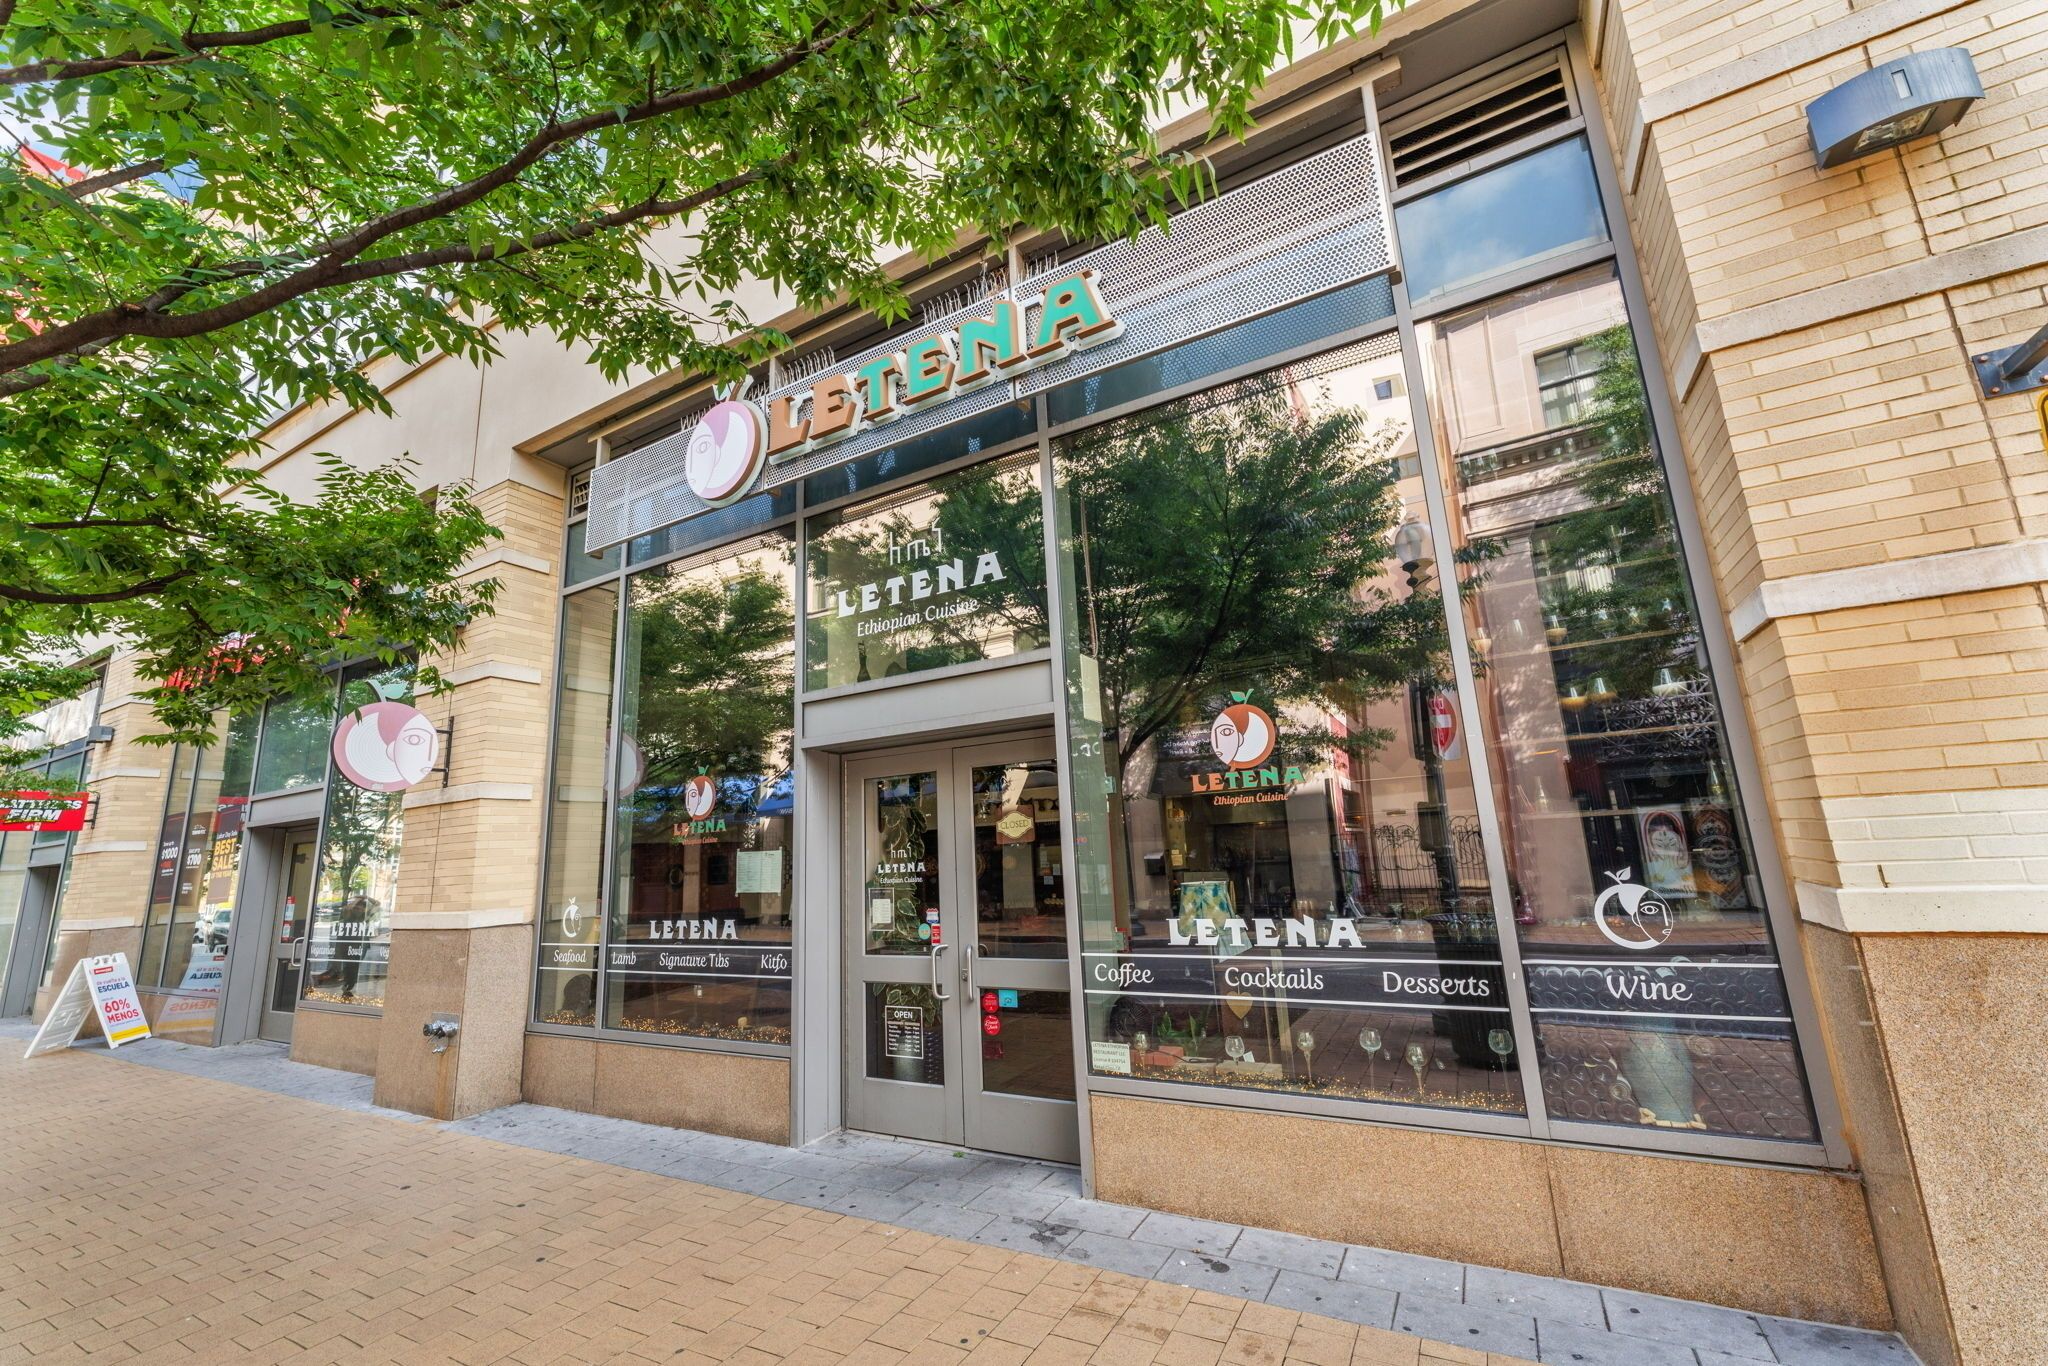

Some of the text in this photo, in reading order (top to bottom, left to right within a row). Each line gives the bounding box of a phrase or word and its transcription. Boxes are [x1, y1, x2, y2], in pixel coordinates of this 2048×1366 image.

[767, 269, 1121, 456] LETENA
[837, 550, 1007, 619] LETENA
[857, 597, 980, 638] Ethiopian Cuisine
[1190, 765, 1306, 793] LETENA
[1213, 792, 1289, 807] Ethiopian Cuisine
[8, 809, 62, 820] FIRM
[673, 818, 727, 836] LETENA
[1001, 819, 1029, 830] CLOSED
[214, 837, 237, 856] BEST
[212, 854, 235, 872] SALE
[877, 861, 927, 874] LETENA
[331, 921, 375, 937] LETENA
[649, 916, 739, 940] LETENA
[1165, 914, 1367, 950] LETENA
[553, 949, 587, 964] Seafood
[611, 951, 788, 974] Lamb Signature Tibs Kitfo
[98, 981, 130, 993] ESCUELA
[1094, 962, 1490, 996] Coffee Cocktails Desserts
[1606, 975, 1693, 1001] Wine
[104, 998, 131, 1014] 60%
[893, 1010, 913, 1019] OPEN
[107, 1008, 139, 1024] MENOS
